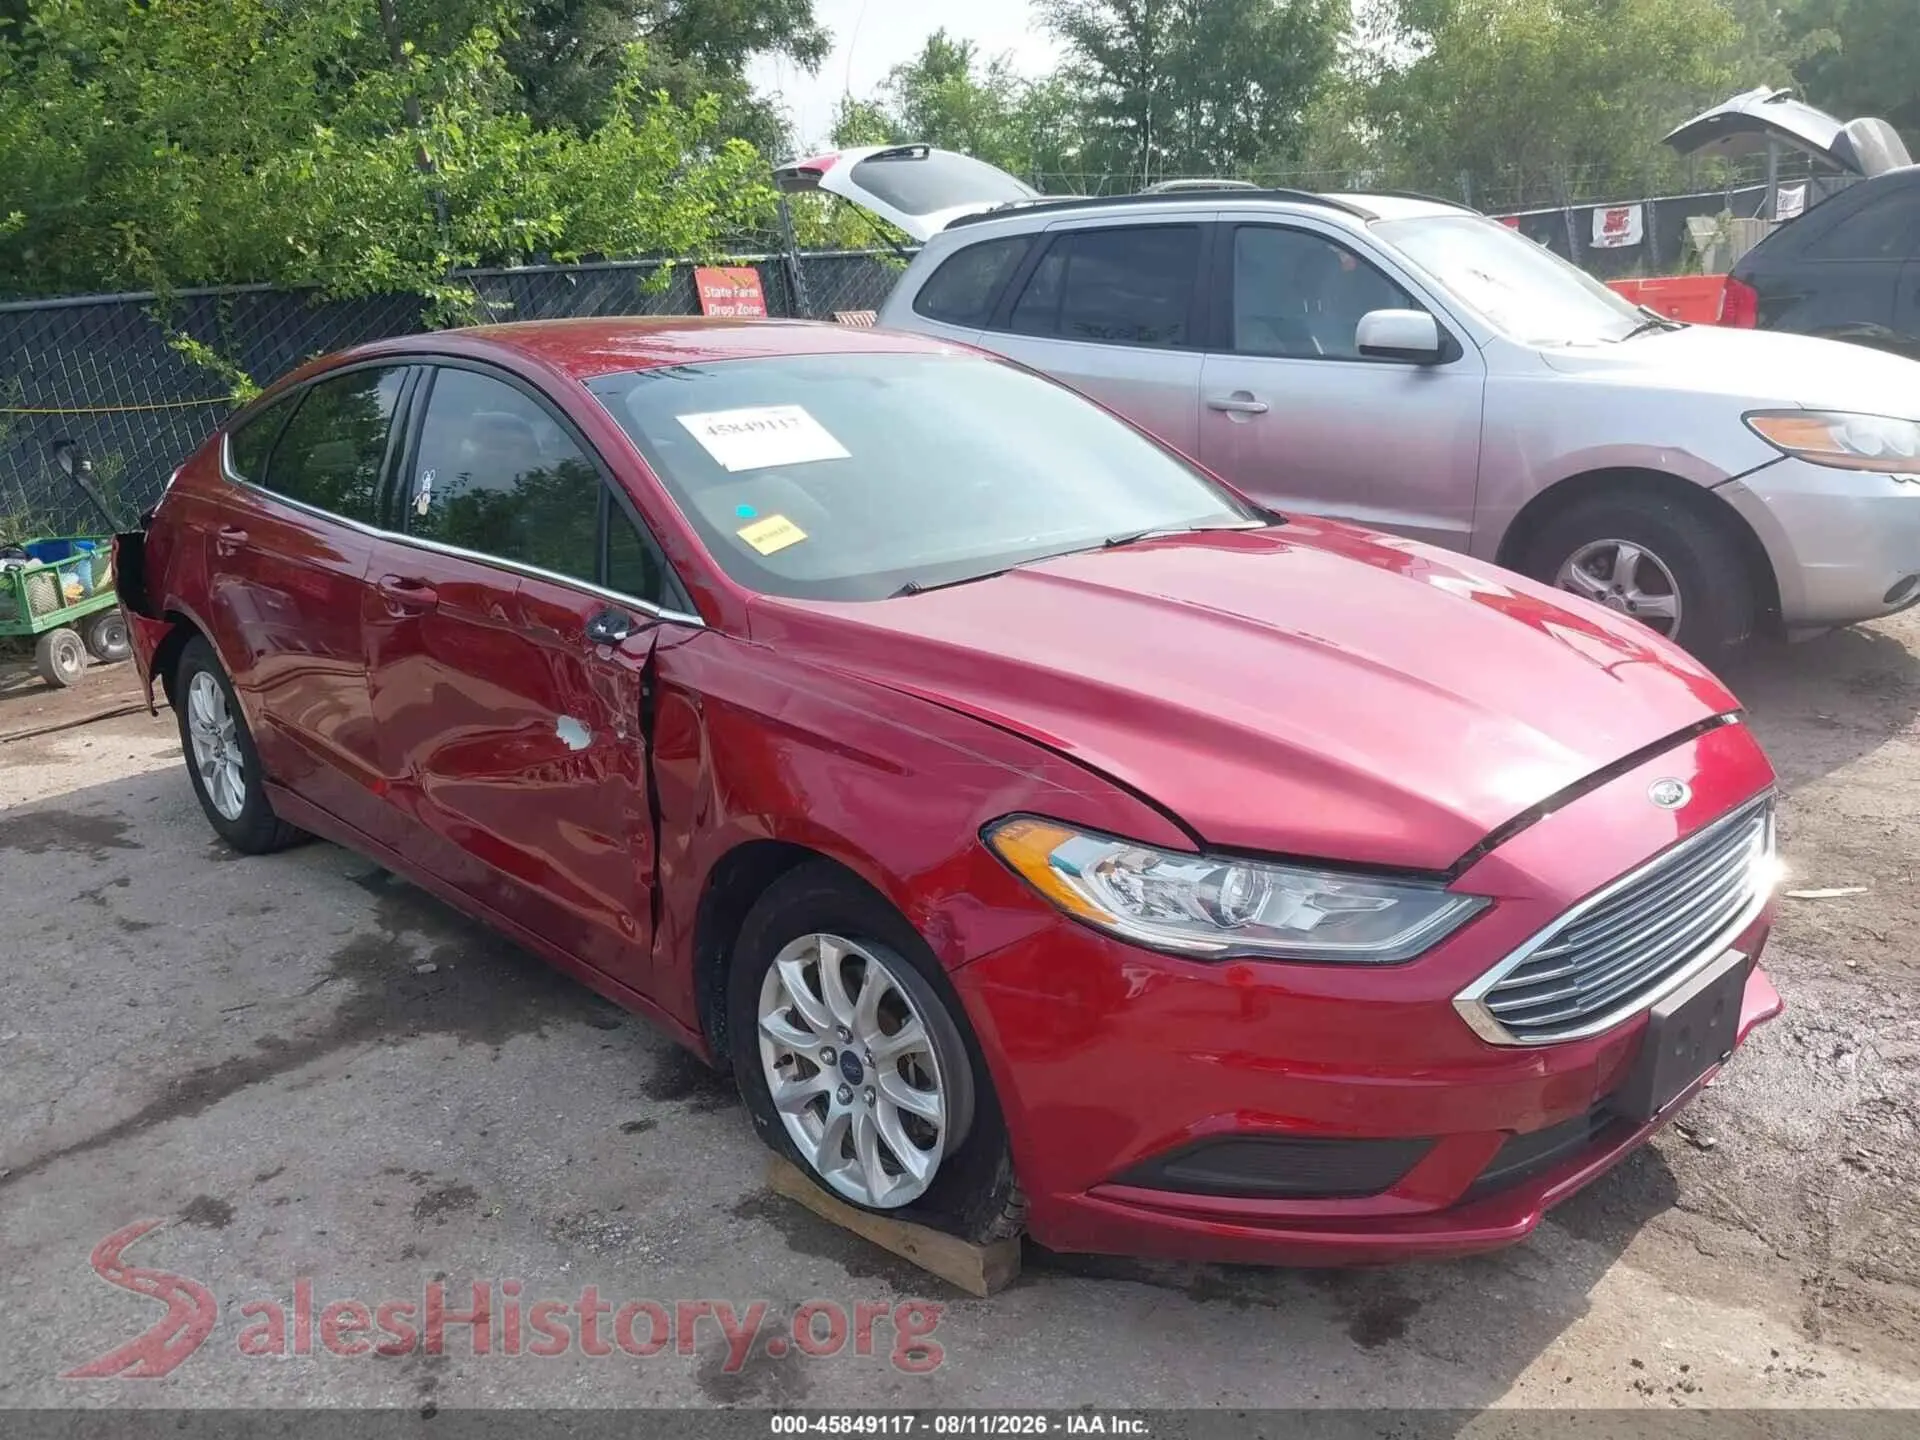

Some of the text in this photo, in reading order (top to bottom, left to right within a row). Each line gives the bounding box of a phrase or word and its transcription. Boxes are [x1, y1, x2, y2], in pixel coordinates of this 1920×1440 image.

[704, 286, 758, 298] State Farm
[708, 302, 761, 317] Drop Zone
